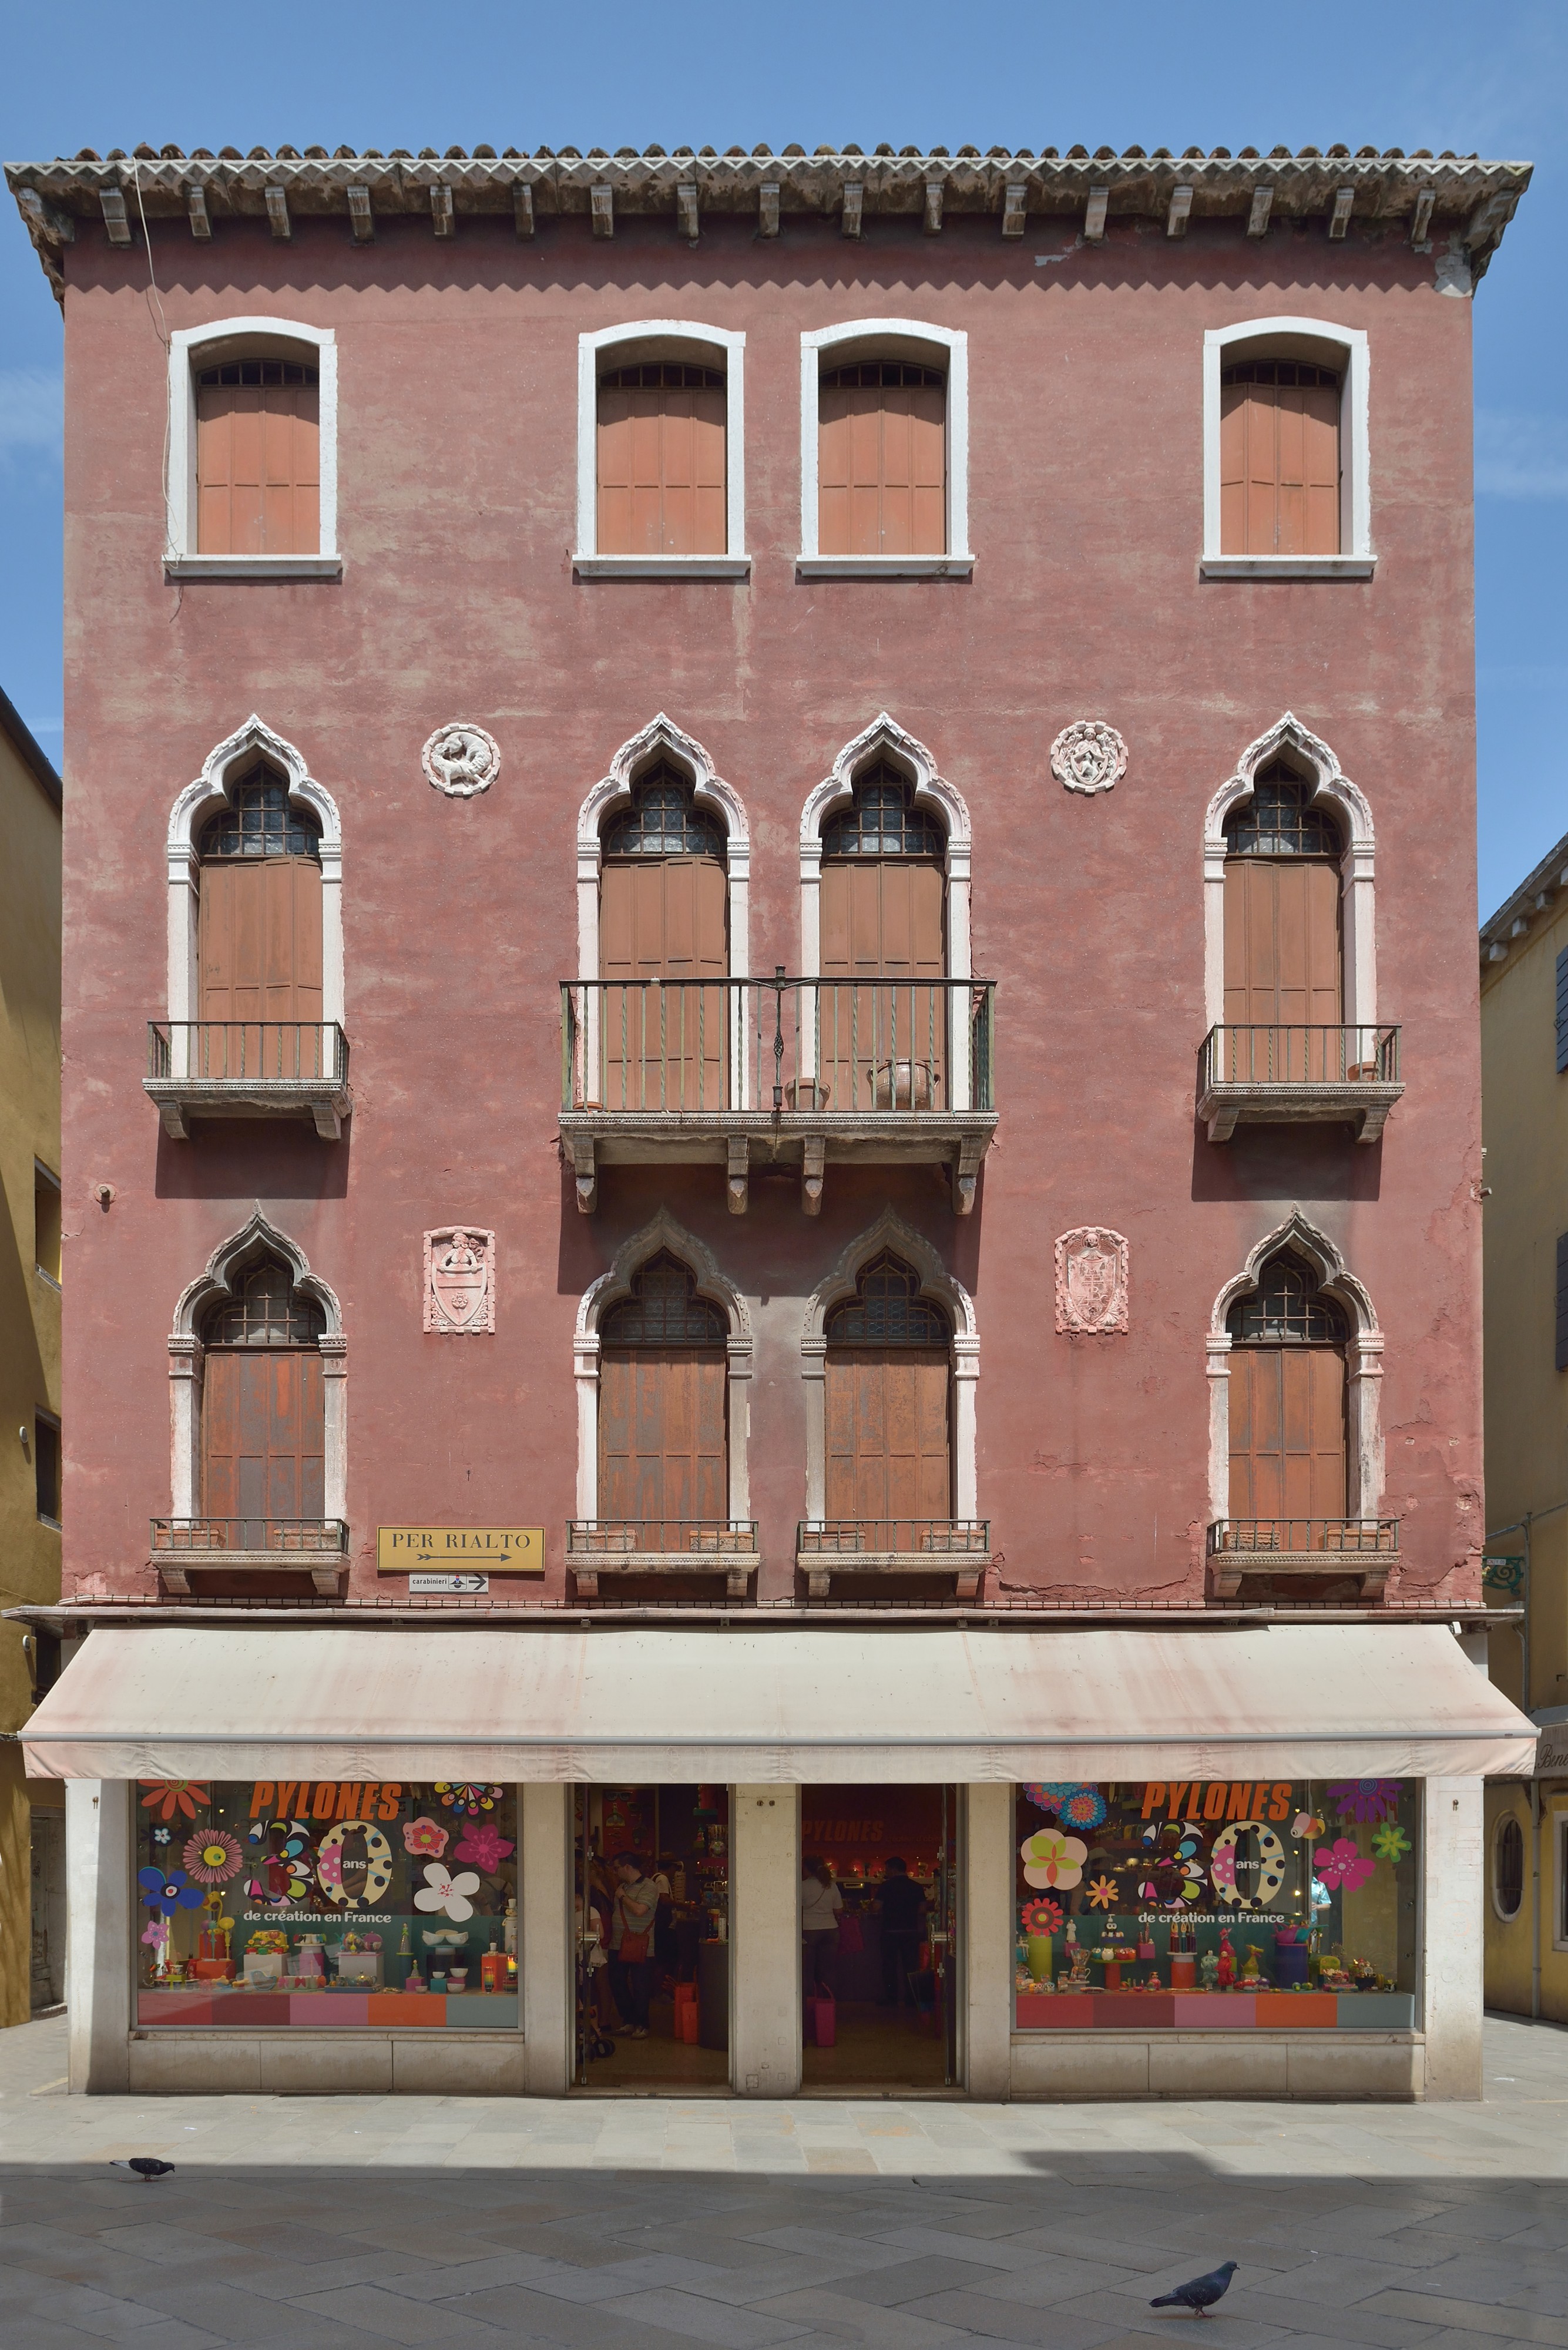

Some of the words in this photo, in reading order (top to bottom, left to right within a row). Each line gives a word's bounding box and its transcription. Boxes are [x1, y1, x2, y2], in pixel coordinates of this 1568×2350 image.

[392, 1533, 434, 1547] PER
[445, 1533, 530, 1549] RIALTO
[249, 1782, 402, 1820] PYLONES
[1141, 1782, 1292, 1821] PYLONES
[802, 1820, 884, 1842] PYLONES
[243, 1820, 392, 1908] 30
[343, 1858, 366, 1869] ans
[1138, 1820, 1285, 1909] 30
[1236, 1858, 1260, 1869] ans
[243, 1911, 261, 1921] de
[264, 1911, 320, 1922] création
[324, 1913, 341, 1922] en
[344, 1911, 392, 1923] France
[1138, 1912, 1156, 1923] de
[1159, 1912, 1216, 1923] création
[1218, 1915, 1236, 1923] en
[1238, 1912, 1285, 1924] France
